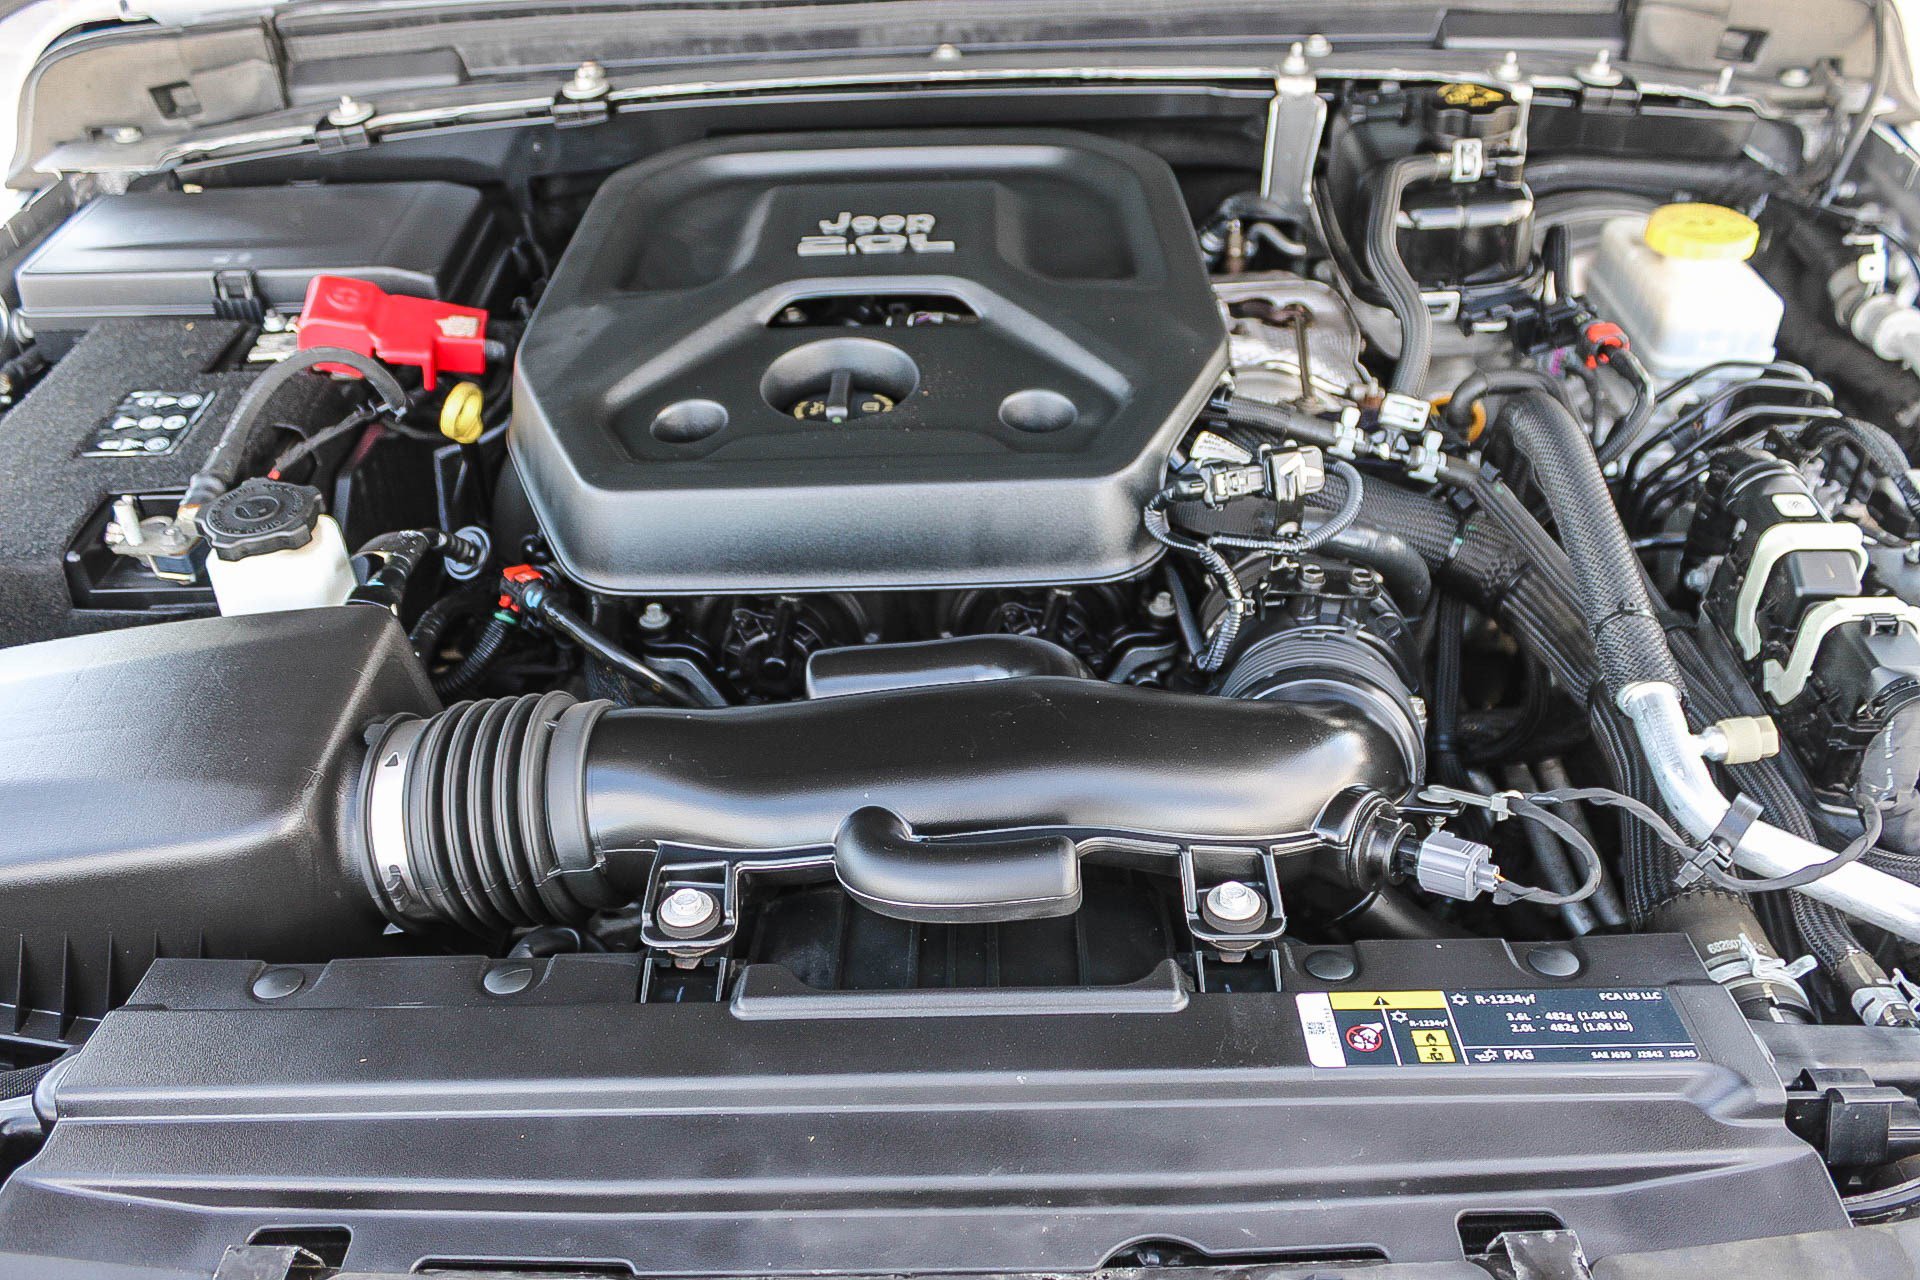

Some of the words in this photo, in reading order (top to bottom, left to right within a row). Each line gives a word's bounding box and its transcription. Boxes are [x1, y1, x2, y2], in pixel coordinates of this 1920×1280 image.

[818, 211, 935, 235] Jeep
[797, 233, 955, 257] 2.0L
[1474, 993, 1536, 1006] R-1234yf
[1598, 991, 1623, 1001] FCA
[1622, 991, 1641, 1001] US
[1640, 991, 1662, 1000] LLC
[1505, 1012, 1532, 1021] 3.6L
[1545, 1011, 1575, 1022] 482g
[1408, 1018, 1448, 1028] R-1234yf
[1510, 1023, 1537, 1033] 2.0L
[1550, 1023, 1580, 1034] 482g
[1503, 1049, 1535, 1061] PAG
